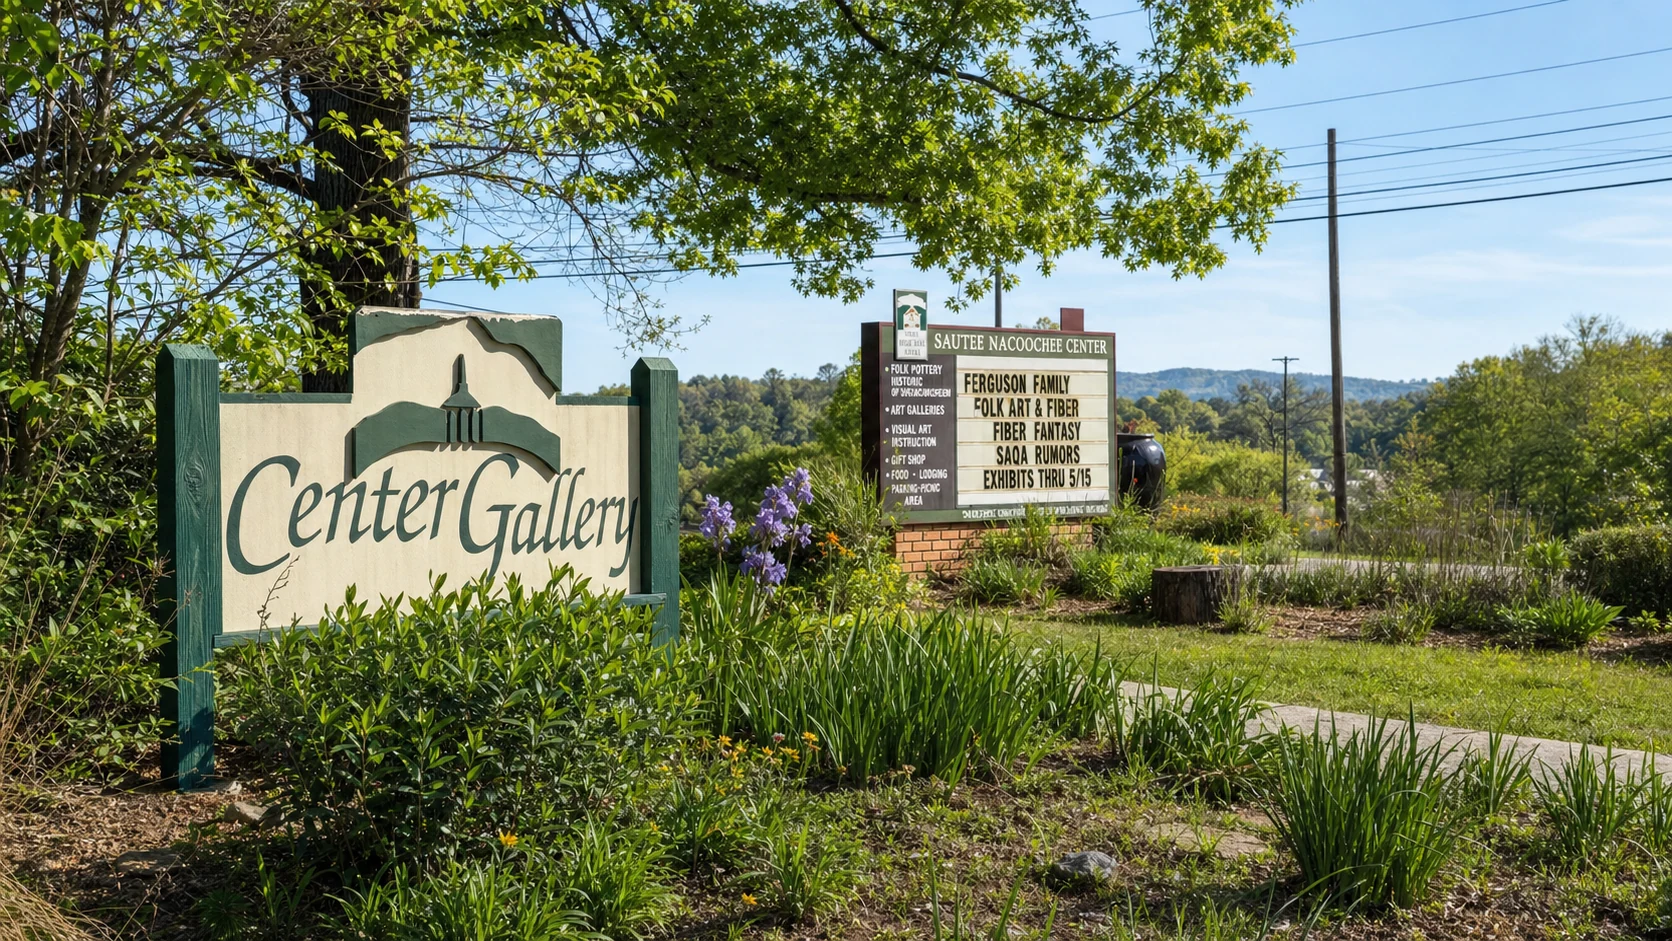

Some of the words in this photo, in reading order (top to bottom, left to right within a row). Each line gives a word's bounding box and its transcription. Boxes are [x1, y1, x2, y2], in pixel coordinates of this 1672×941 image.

[934, 333, 984, 350] SAUTEE
[989, 335, 1062, 353] NACOOCHEE
[1066, 338, 1107, 354] CENTER
[891, 364, 909, 374] FOLK
[911, 364, 943, 375] POTTERY
[964, 373, 1027, 394] FERGUSON
[1033, 374, 1070, 394] FAMILY
[890, 404, 905, 415] ART
[906, 404, 945, 415] GALLERIES
[974, 397, 1004, 418] FOLK
[1009, 398, 1031, 418] ART
[1034, 398, 1043, 417] &
[1047, 398, 1079, 418] FIBER
[891, 424, 916, 435] VISUAL
[918, 424, 932, 434] ART
[993, 421, 1026, 441] FIBER
[1034, 421, 1081, 441] FANTASY
[891, 454, 906, 465] GIFT
[907, 454, 926, 465] SHOP
[996, 445, 1028, 465] SAQA
[1035, 444, 1080, 465] RUMORS
[983, 468, 1034, 490] EXHIBITS
[1038, 468, 1065, 488] THRU
[1069, 468, 1091, 487] 5/15
[904, 495, 923, 506] AREA
[226, 455, 459, 576] Center
[459, 453, 639, 592] Gallery
